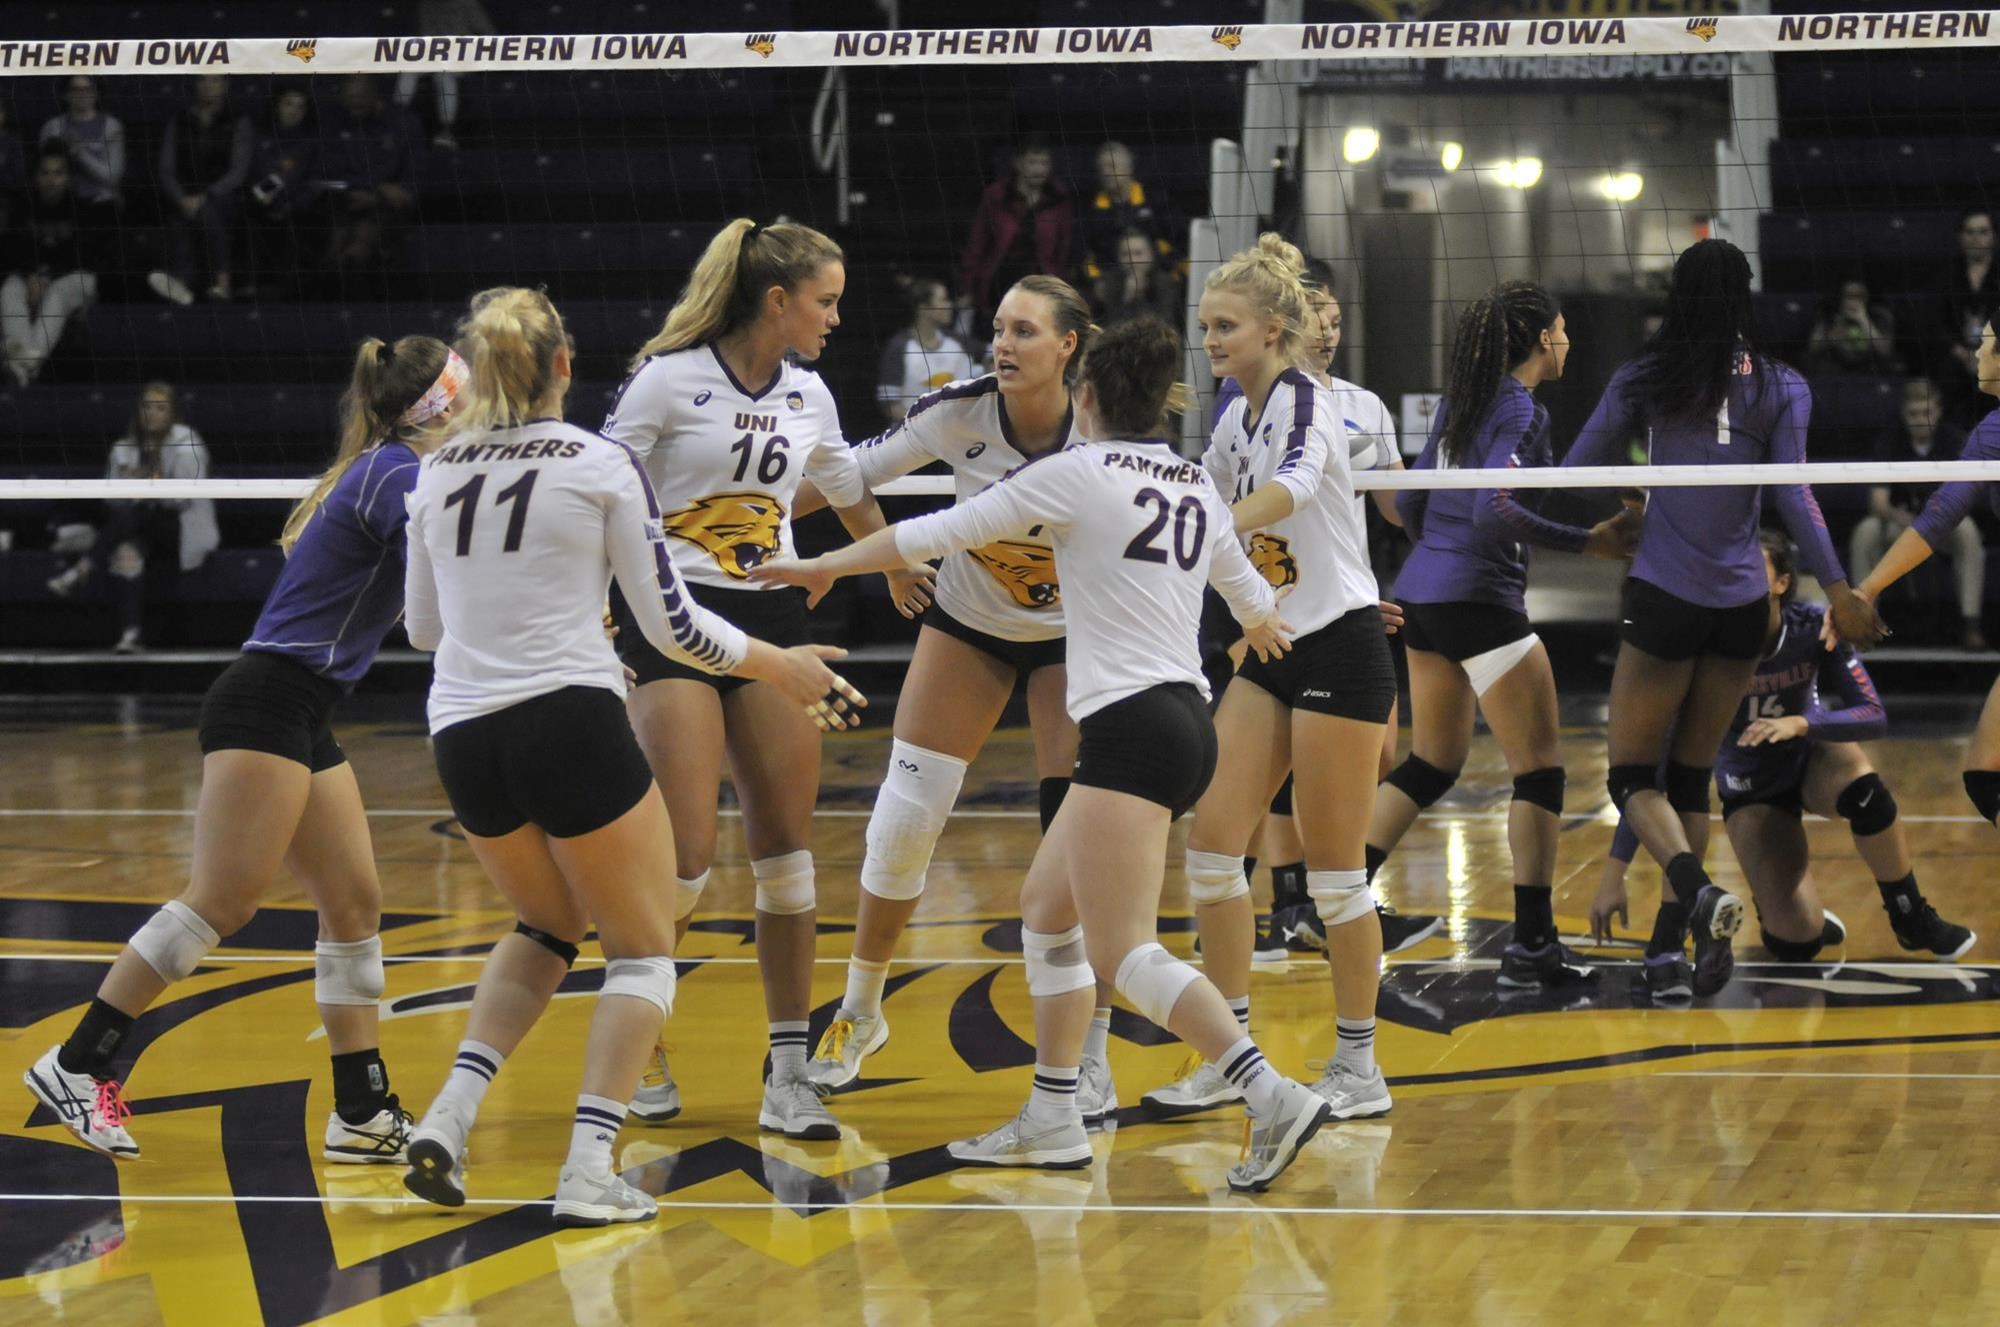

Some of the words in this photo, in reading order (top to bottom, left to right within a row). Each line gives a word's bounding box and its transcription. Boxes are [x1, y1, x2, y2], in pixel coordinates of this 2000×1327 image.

[1301, 22, 1510, 49] NORTHERN
[1527, 20, 1626, 46] IOWA
[1778, 12, 1990, 41] NORTHERN
[1, 42, 119, 67] THERN
[135, 41, 230, 65] IOWA
[374, 36, 576, 62] NORTHERN
[592, 35, 687, 60] IOWA
[834, 29, 1039, 57] NORTHERN
[1056, 28, 1153, 53] IOWA
[734, 412, 778, 432] UNI
[730, 432, 790, 485] 16
[443, 469, 539, 557] 11
[1122, 487, 1207, 572] 20
[1748, 694, 1785, 721] 14
